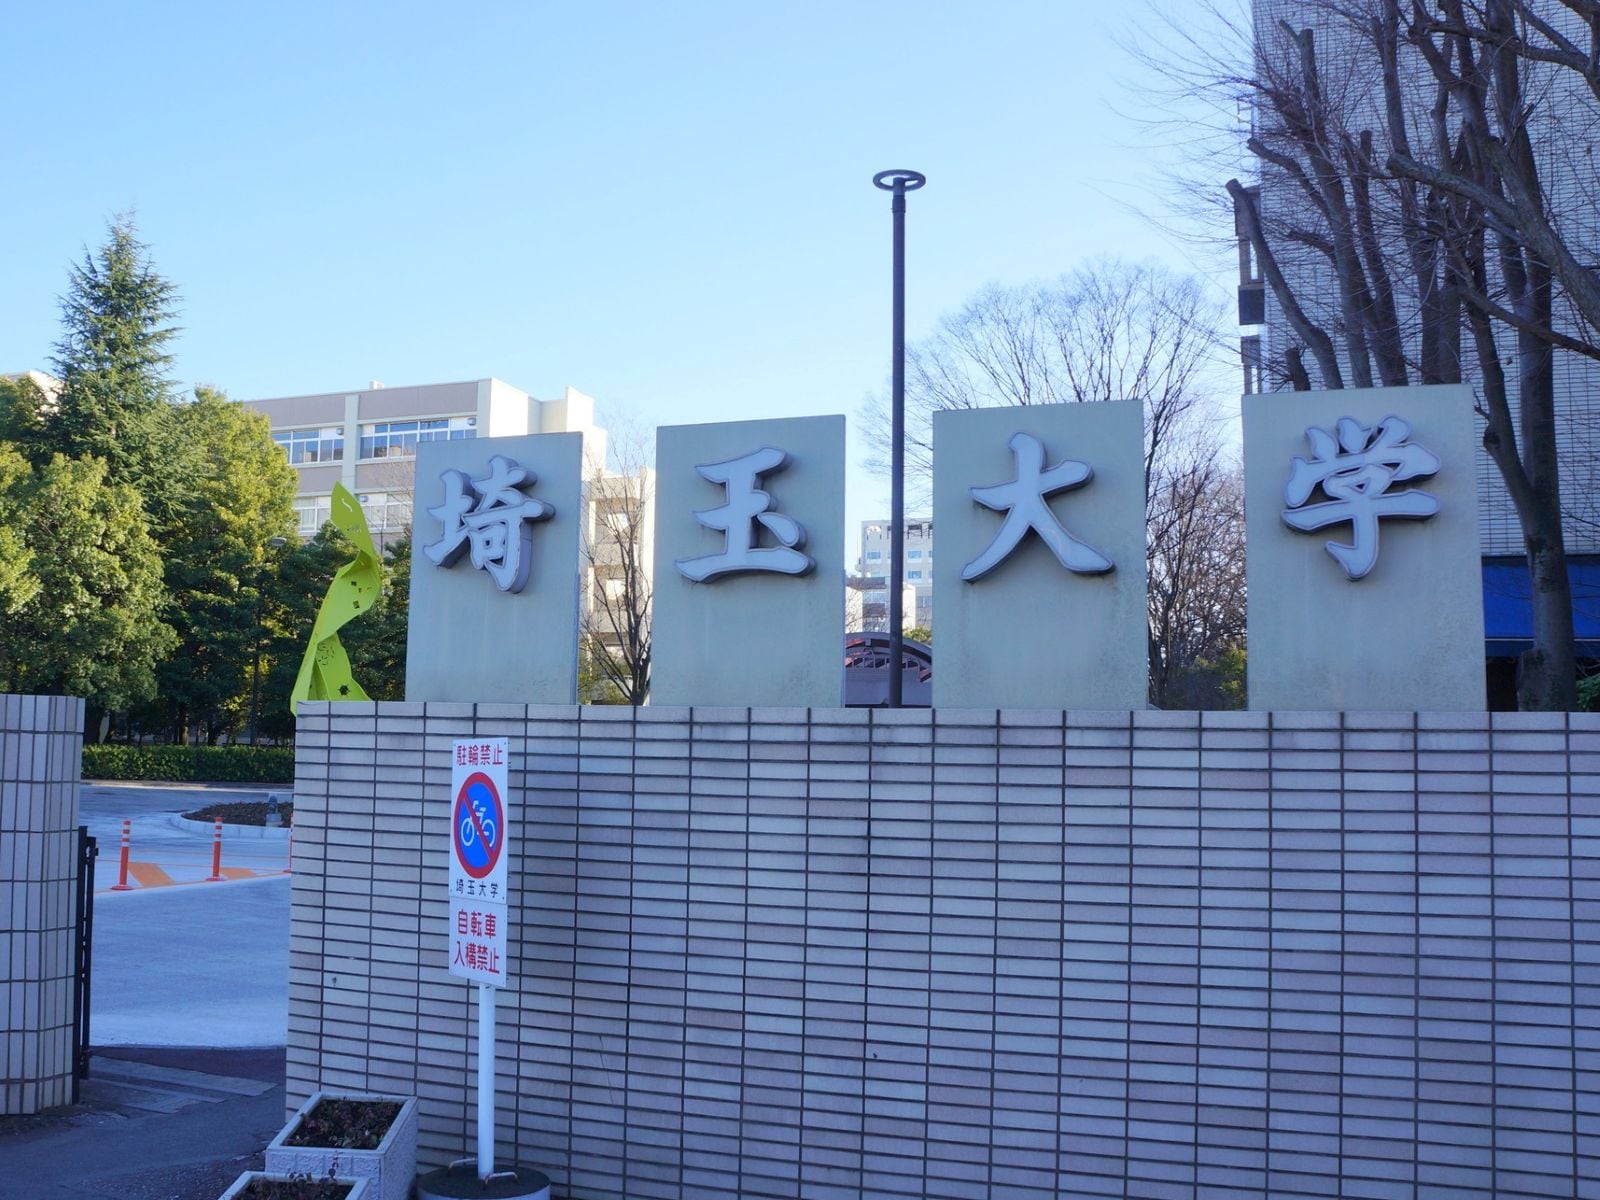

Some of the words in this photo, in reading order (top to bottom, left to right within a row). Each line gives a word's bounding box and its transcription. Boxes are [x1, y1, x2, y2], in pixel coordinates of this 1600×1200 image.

[422, 416, 1442, 593] 埼玉大学
[456, 744, 503, 766] 駐輪禁止
[456, 879, 499, 898] 埼玉大学
[457, 909, 497, 939] 自転車
[454, 941, 500, 974] 入構禁止
